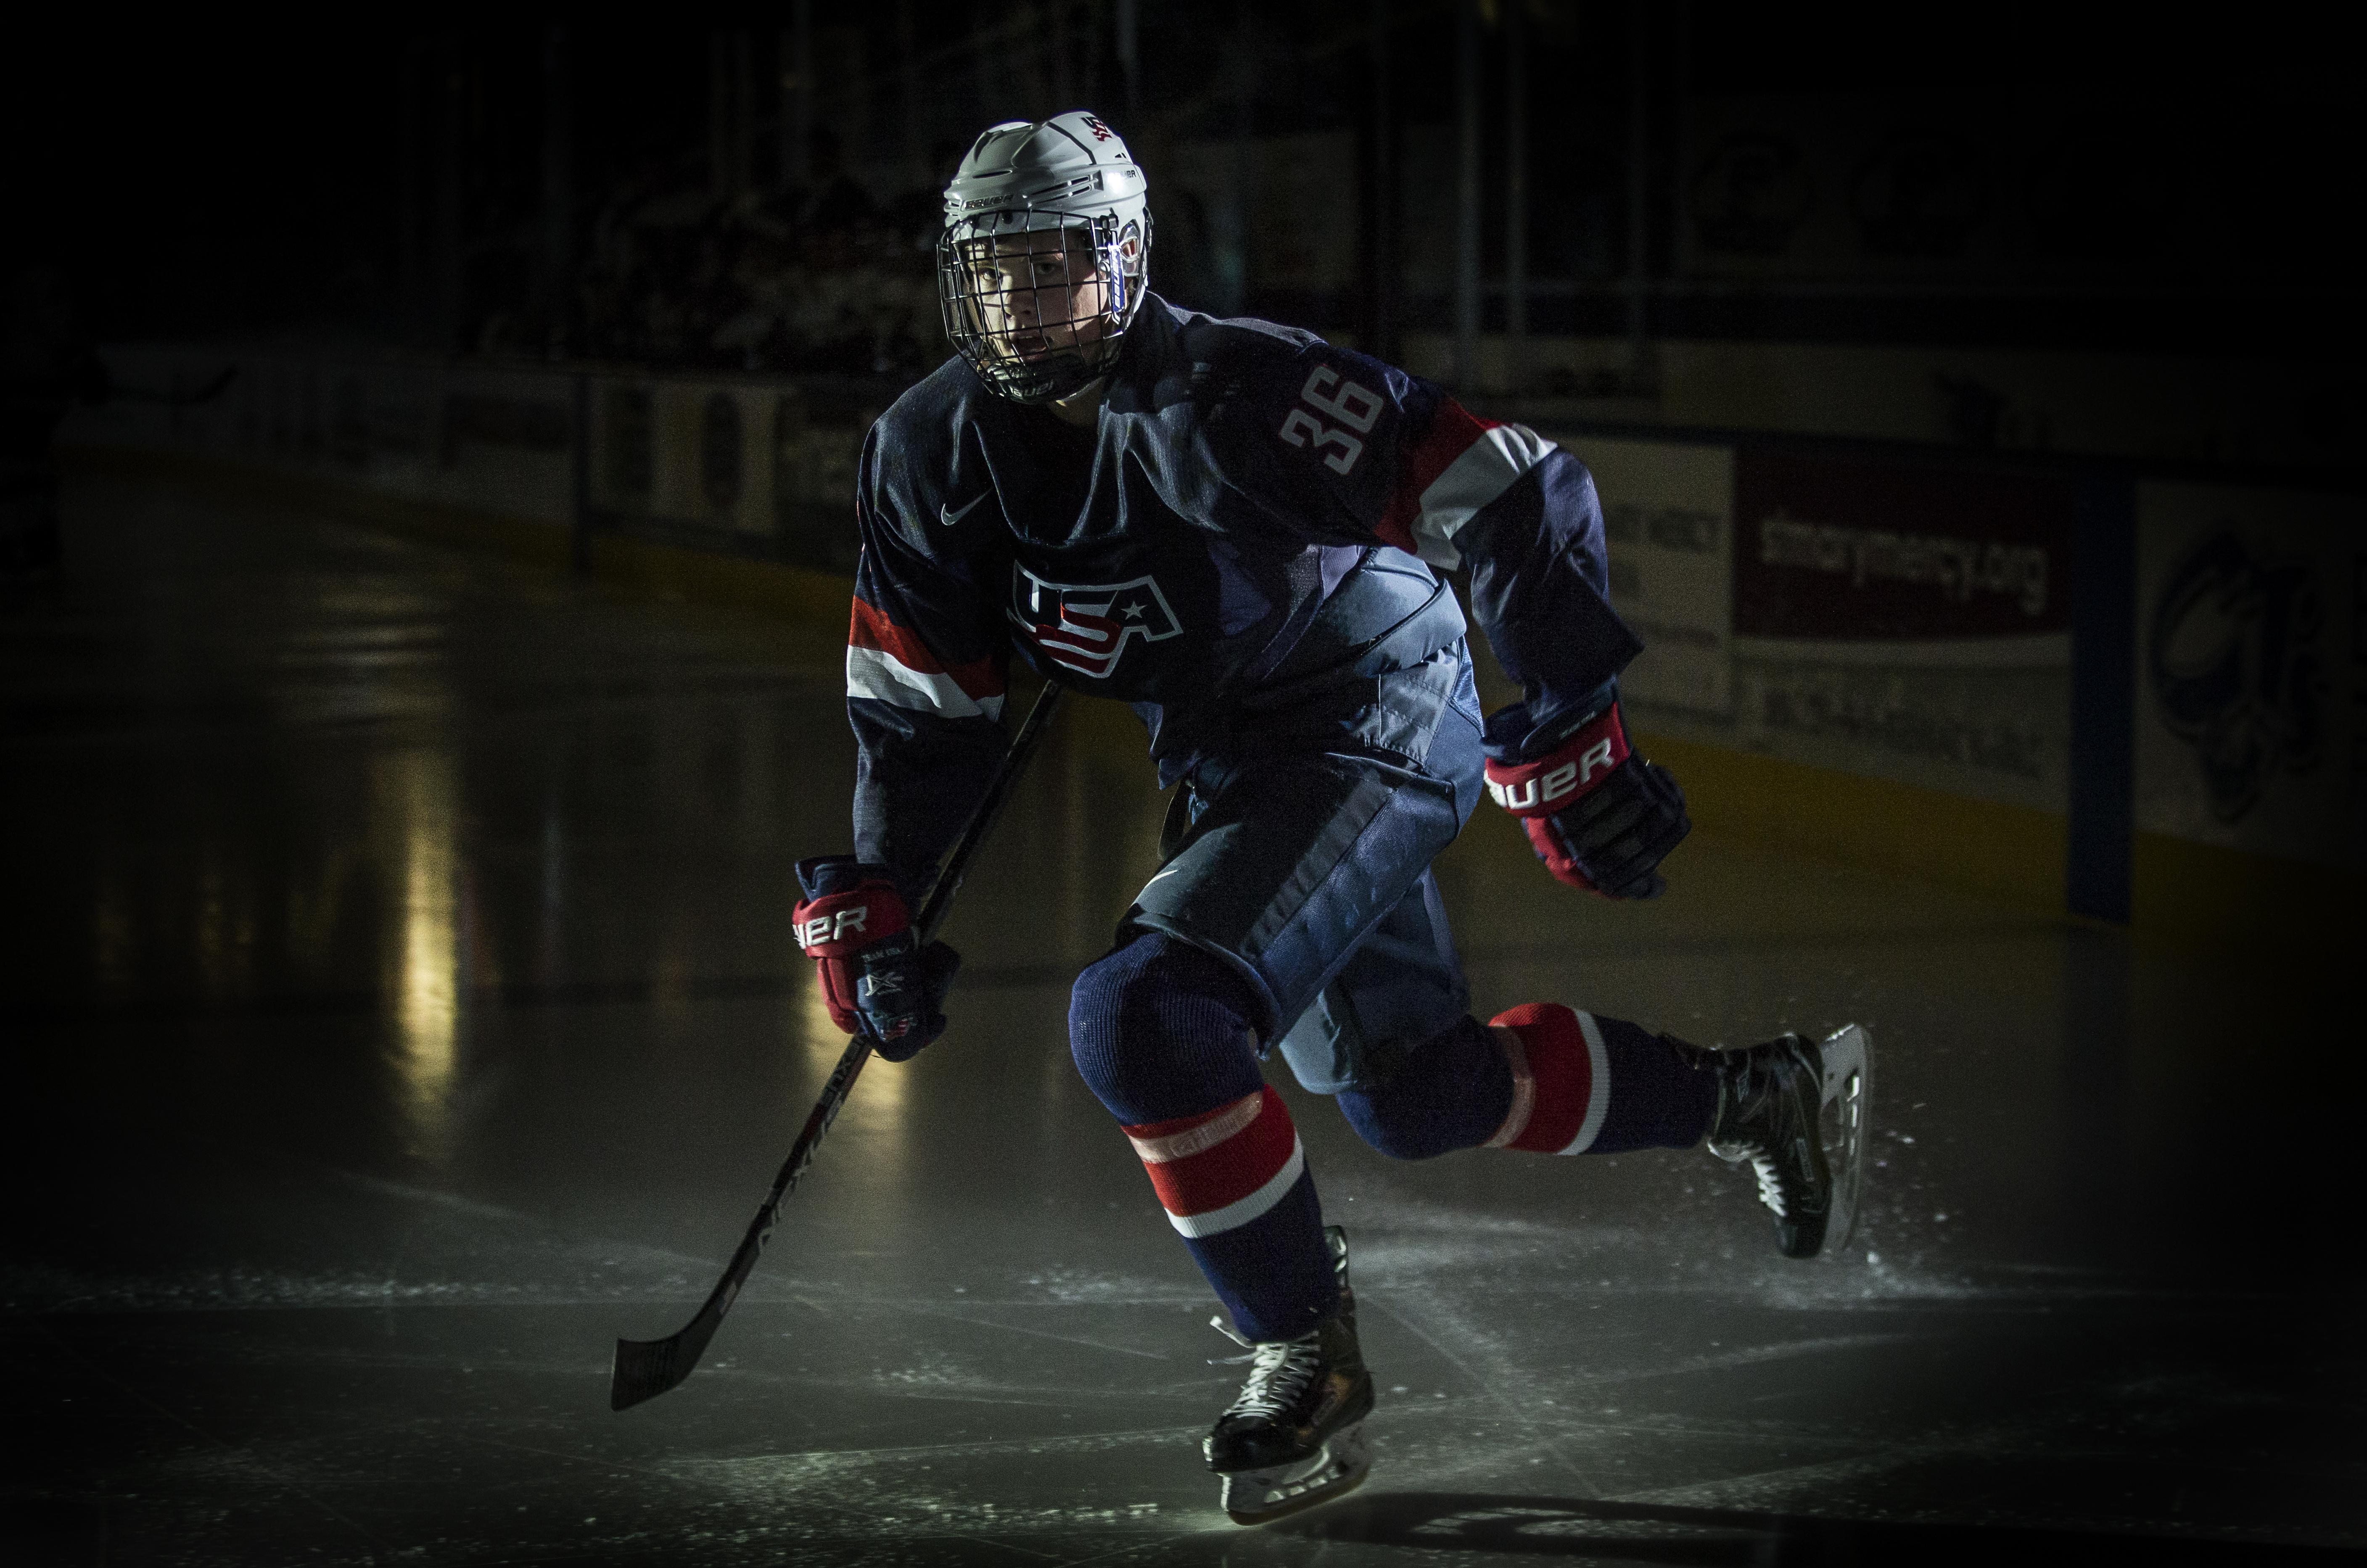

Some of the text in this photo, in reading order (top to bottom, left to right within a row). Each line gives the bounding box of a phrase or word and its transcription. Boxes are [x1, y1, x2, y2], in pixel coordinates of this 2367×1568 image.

[1279, 365, 1385, 475] 36
[1005, 560, 1184, 679] USA
[1485, 737, 1615, 810] UER
[793, 906, 867, 949] UER
